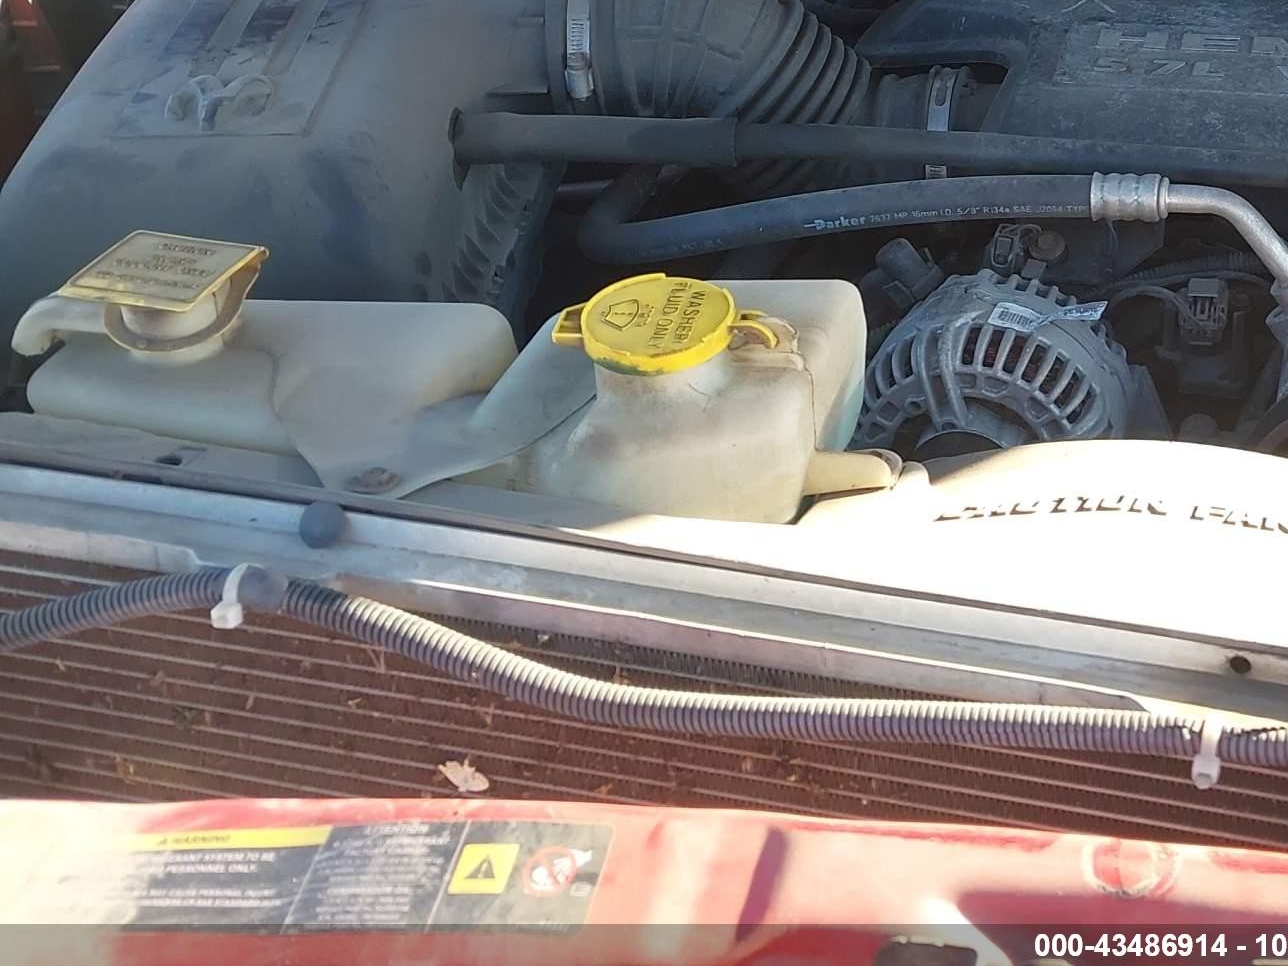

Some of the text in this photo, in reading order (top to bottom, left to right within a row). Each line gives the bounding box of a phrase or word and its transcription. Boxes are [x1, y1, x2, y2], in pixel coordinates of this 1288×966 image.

[804, 215, 866, 230] Parker
[662, 281, 693, 315] FLUID
[647, 317, 674, 349] ONLY
[675, 290, 708, 344] WASHER
